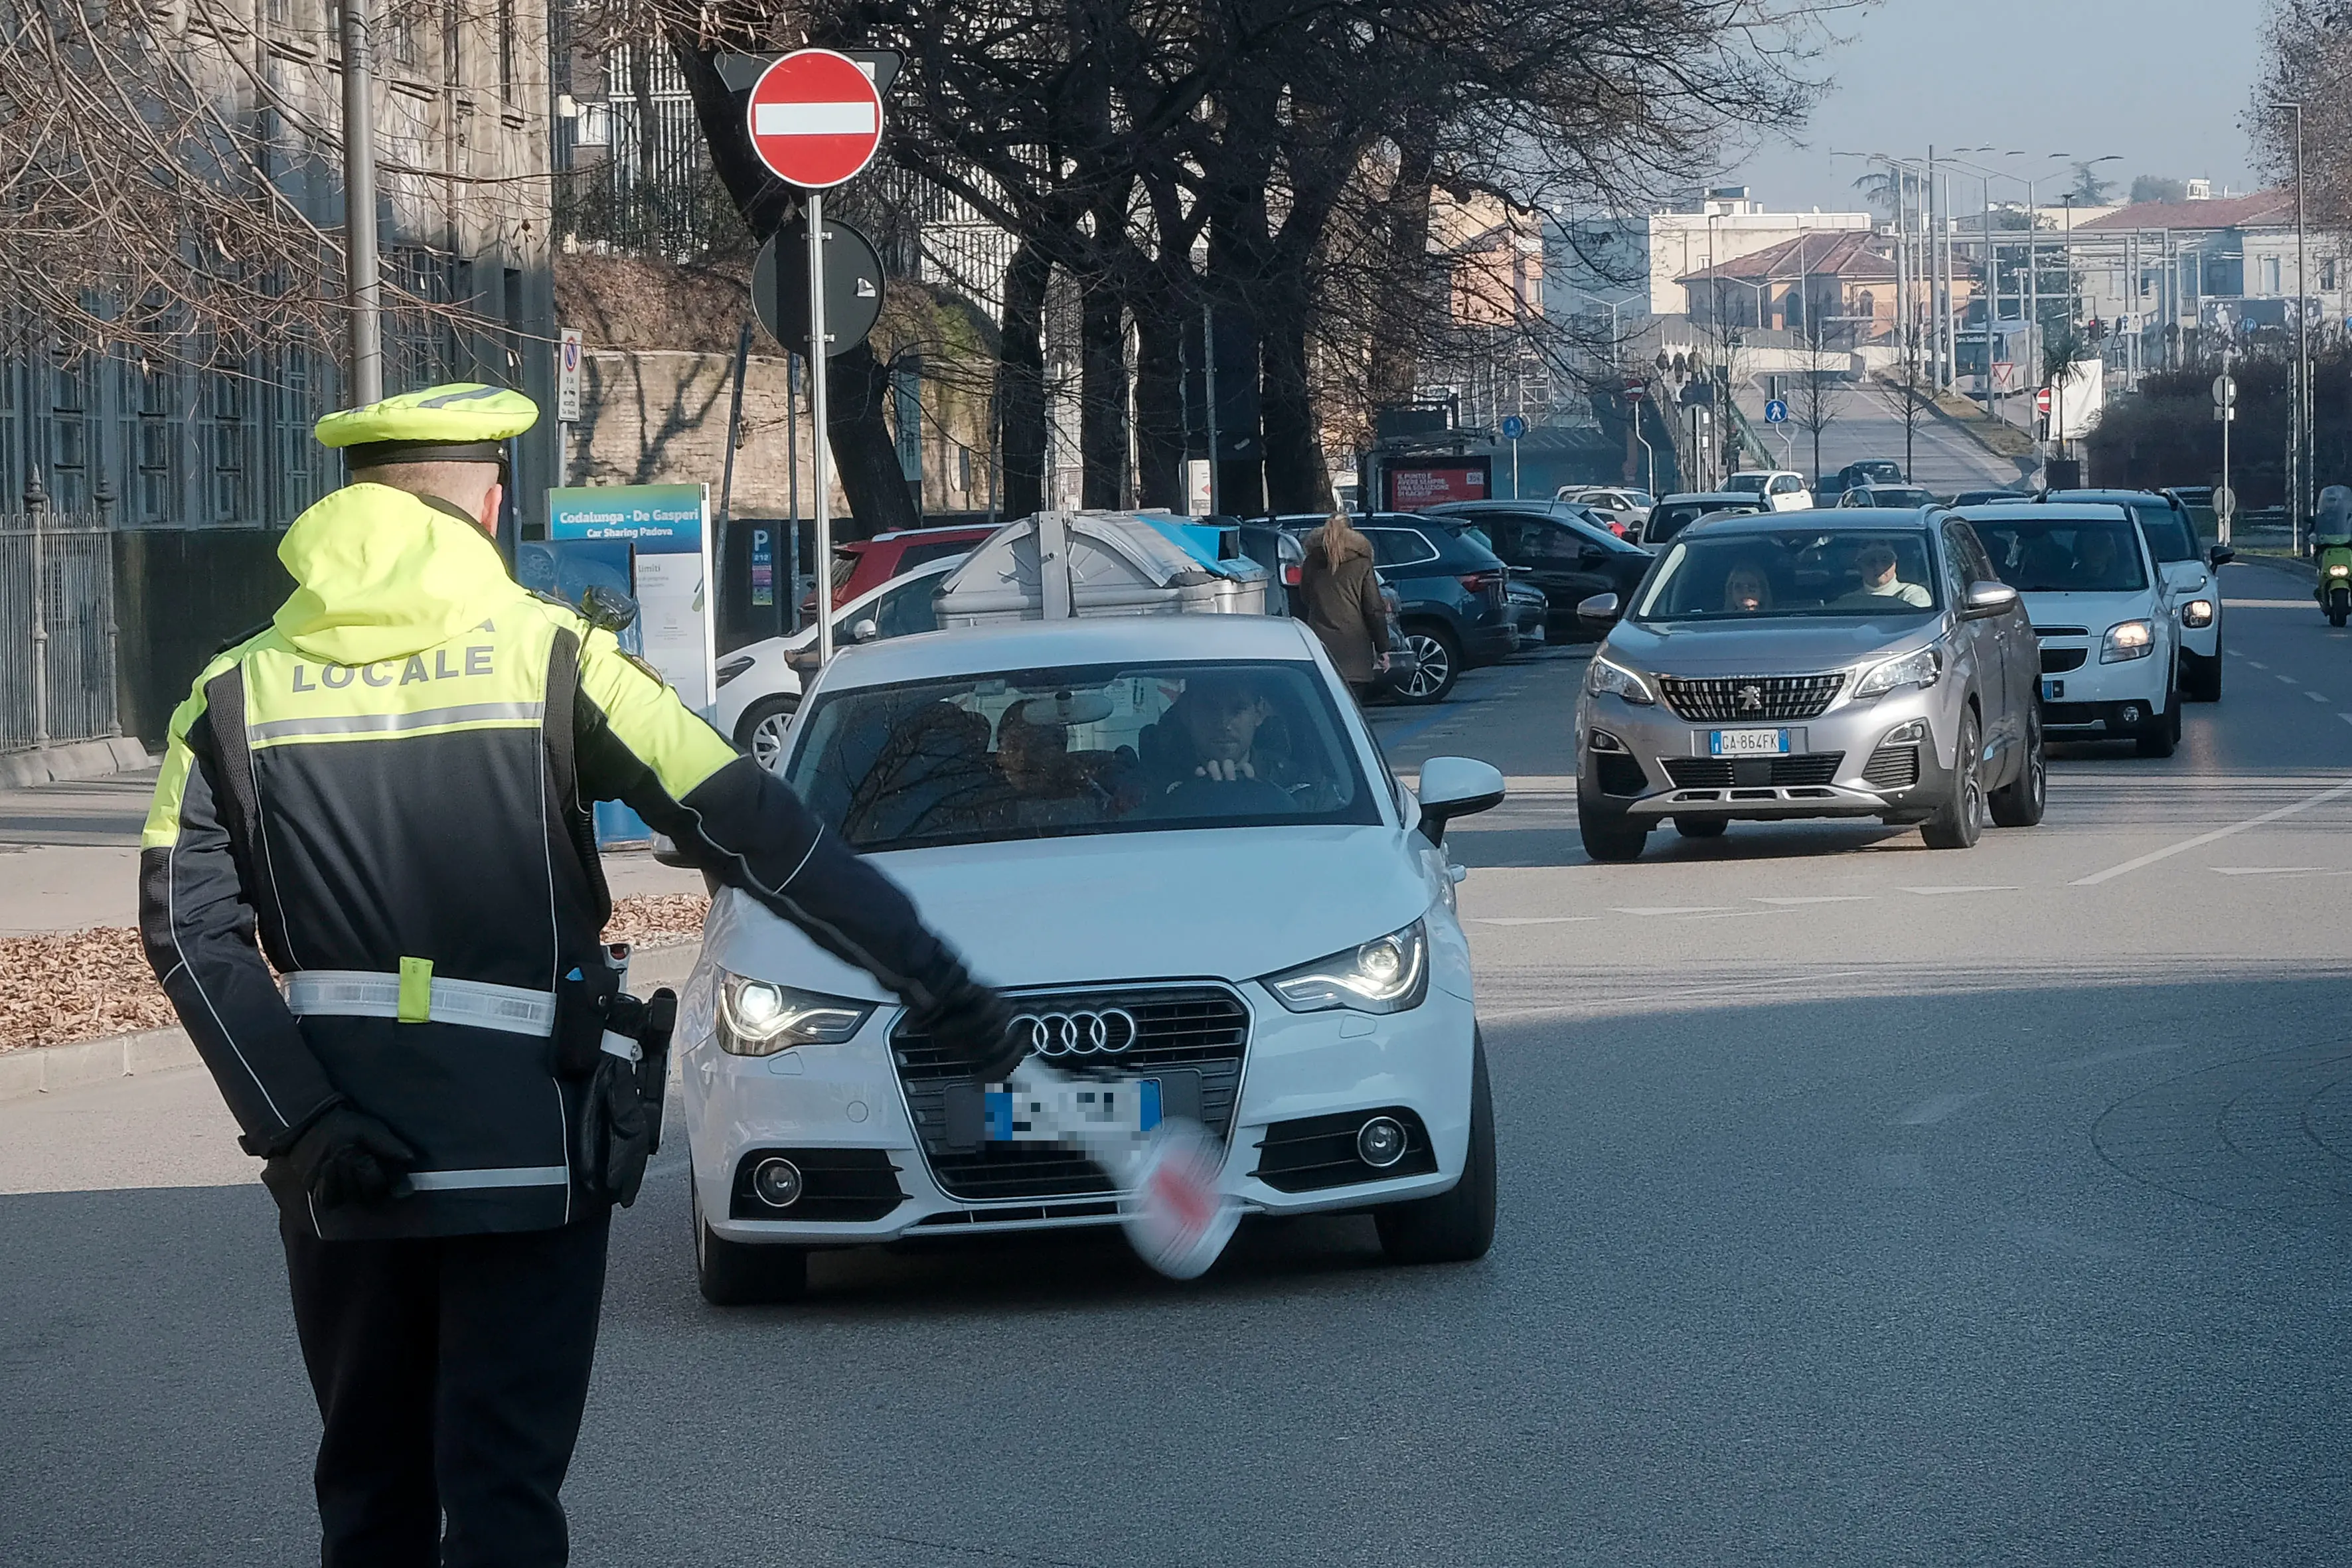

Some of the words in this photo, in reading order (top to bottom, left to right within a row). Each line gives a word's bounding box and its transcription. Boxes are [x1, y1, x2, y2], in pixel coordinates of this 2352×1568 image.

[560, 510, 624, 524] Codalunga
[633, 509, 650, 522] De
[653, 509, 698, 522] Gasperi
[586, 529, 602, 538] Car
[604, 528, 638, 538] Sharing
[640, 527, 672, 536] Padova
[754, 530, 768, 552] P
[293, 646, 494, 692] LOCALE
